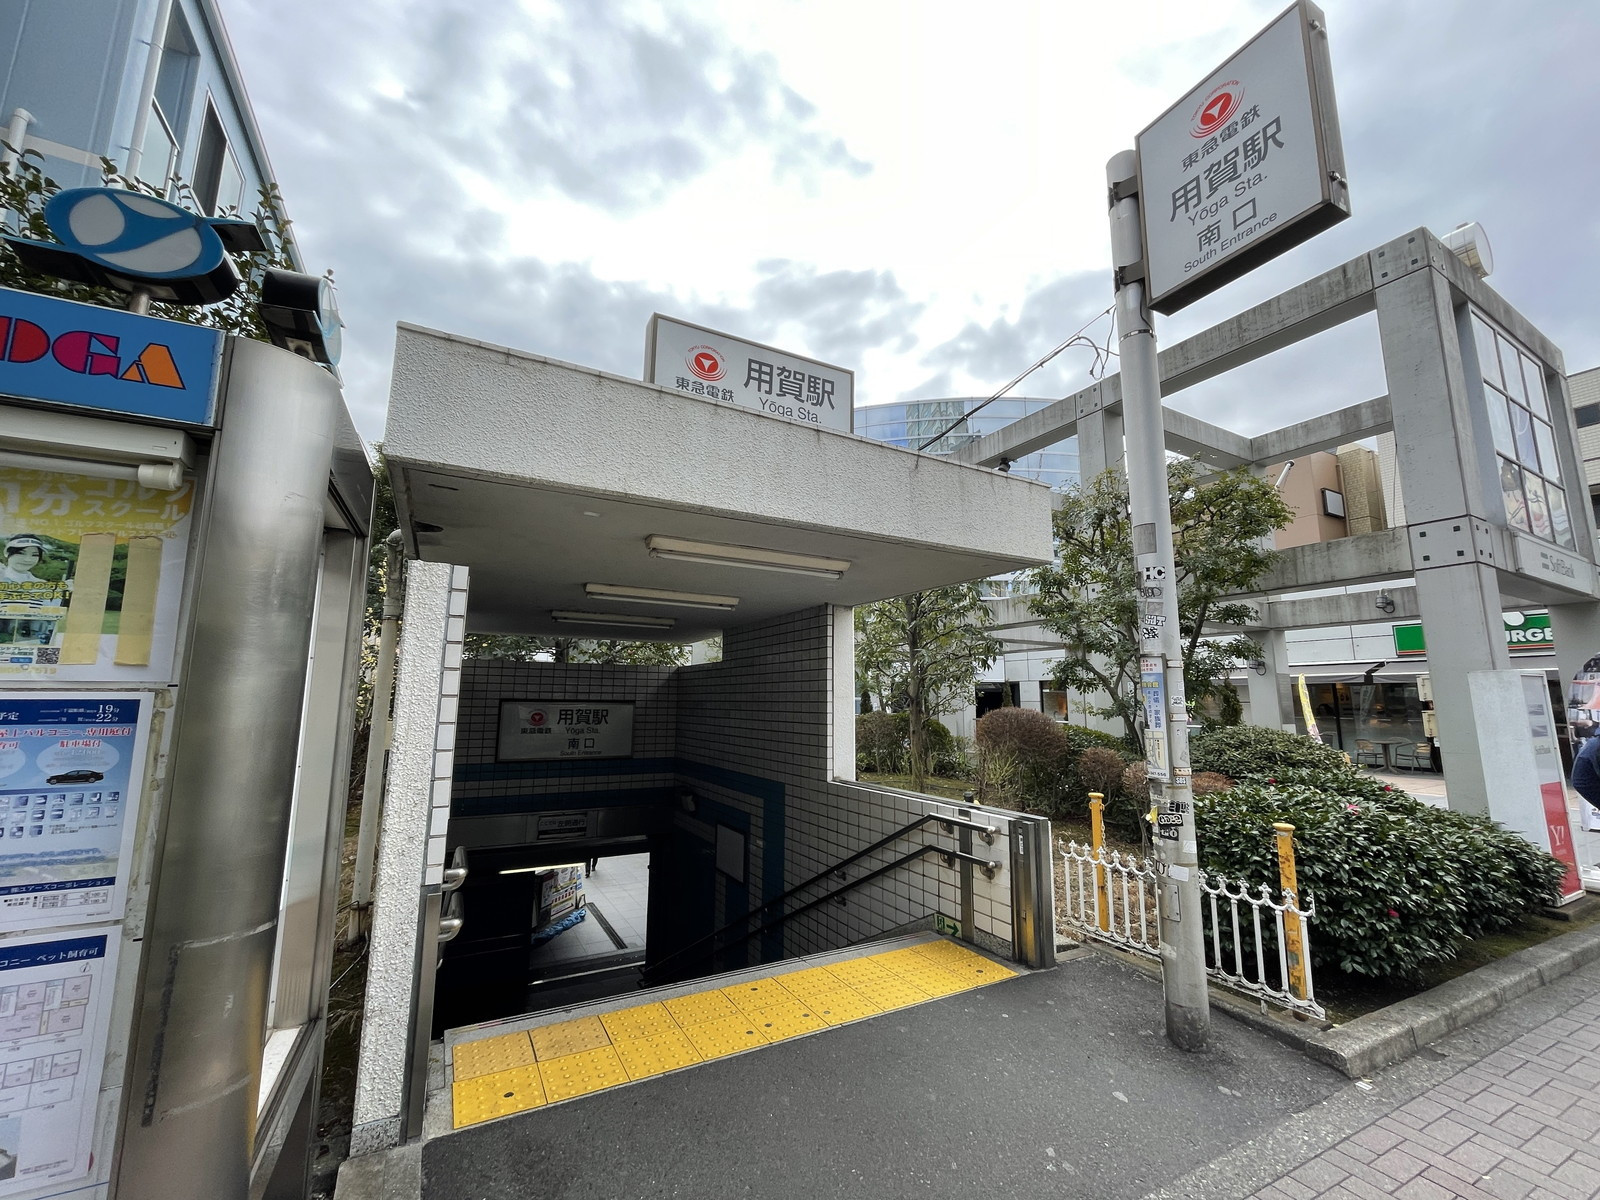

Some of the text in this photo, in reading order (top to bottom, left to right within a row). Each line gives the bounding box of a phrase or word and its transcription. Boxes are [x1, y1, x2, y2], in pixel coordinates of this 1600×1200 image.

[1181, 104, 1261, 173] 東急電鉄
[1170, 115, 1285, 222] 用賀駅
[1188, 173, 1268, 226] Yōga Sta.
[1196, 197, 1257, 252] 南口
[1184, 212, 1278, 273] South Entrance
[675, 376, 735, 403] 東急電鉄
[743, 357, 836, 411] 用賀駅
[759, 397, 822, 424] Yōga Sta.
[82, 499, 186, 521] スクール
[1549, 555, 1576, 579] SoftBank
[557, 708, 609, 726] 用賀駅
[520, 727, 552, 735] 東急電鉄
[586, 726, 601, 734] Sta.
[59, 739, 102, 749] 駐車場付
[567, 737, 595, 750] 南口
[1549, 825, 1565, 847] Y!
